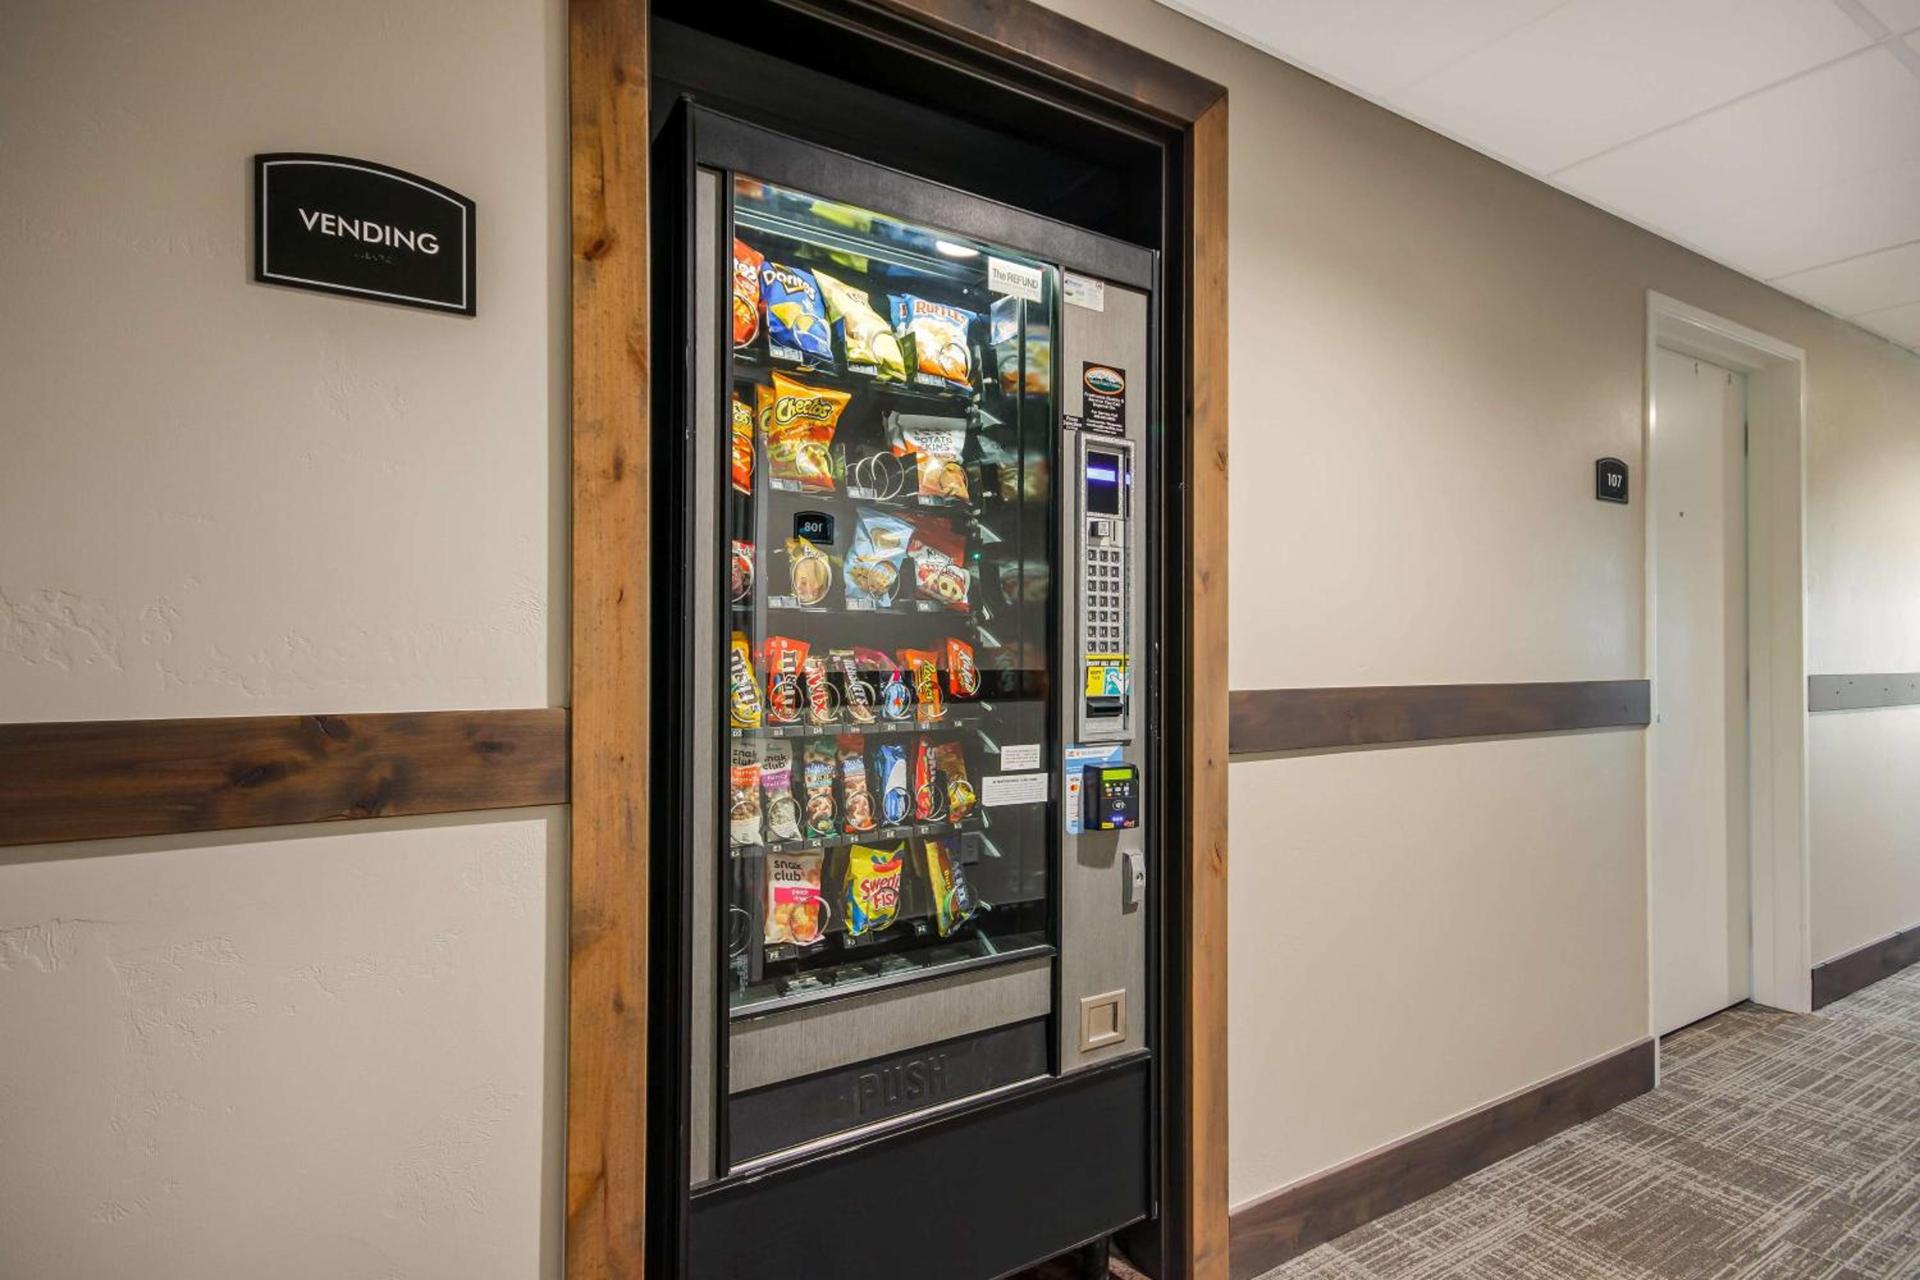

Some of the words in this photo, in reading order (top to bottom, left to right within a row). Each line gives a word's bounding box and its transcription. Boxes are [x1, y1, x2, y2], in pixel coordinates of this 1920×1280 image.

[298, 207, 440, 255] VENDING
[762, 269, 817, 301] Doritos
[992, 267, 1007, 281] The
[1006, 271, 1039, 289] REFUND
[915, 300, 966, 325] RUFFLES
[776, 397, 833, 424] Cheetos
[1607, 473, 1623, 488] 107
[774, 871, 801, 881] club
[855, 1053, 946, 1113] PUSH
